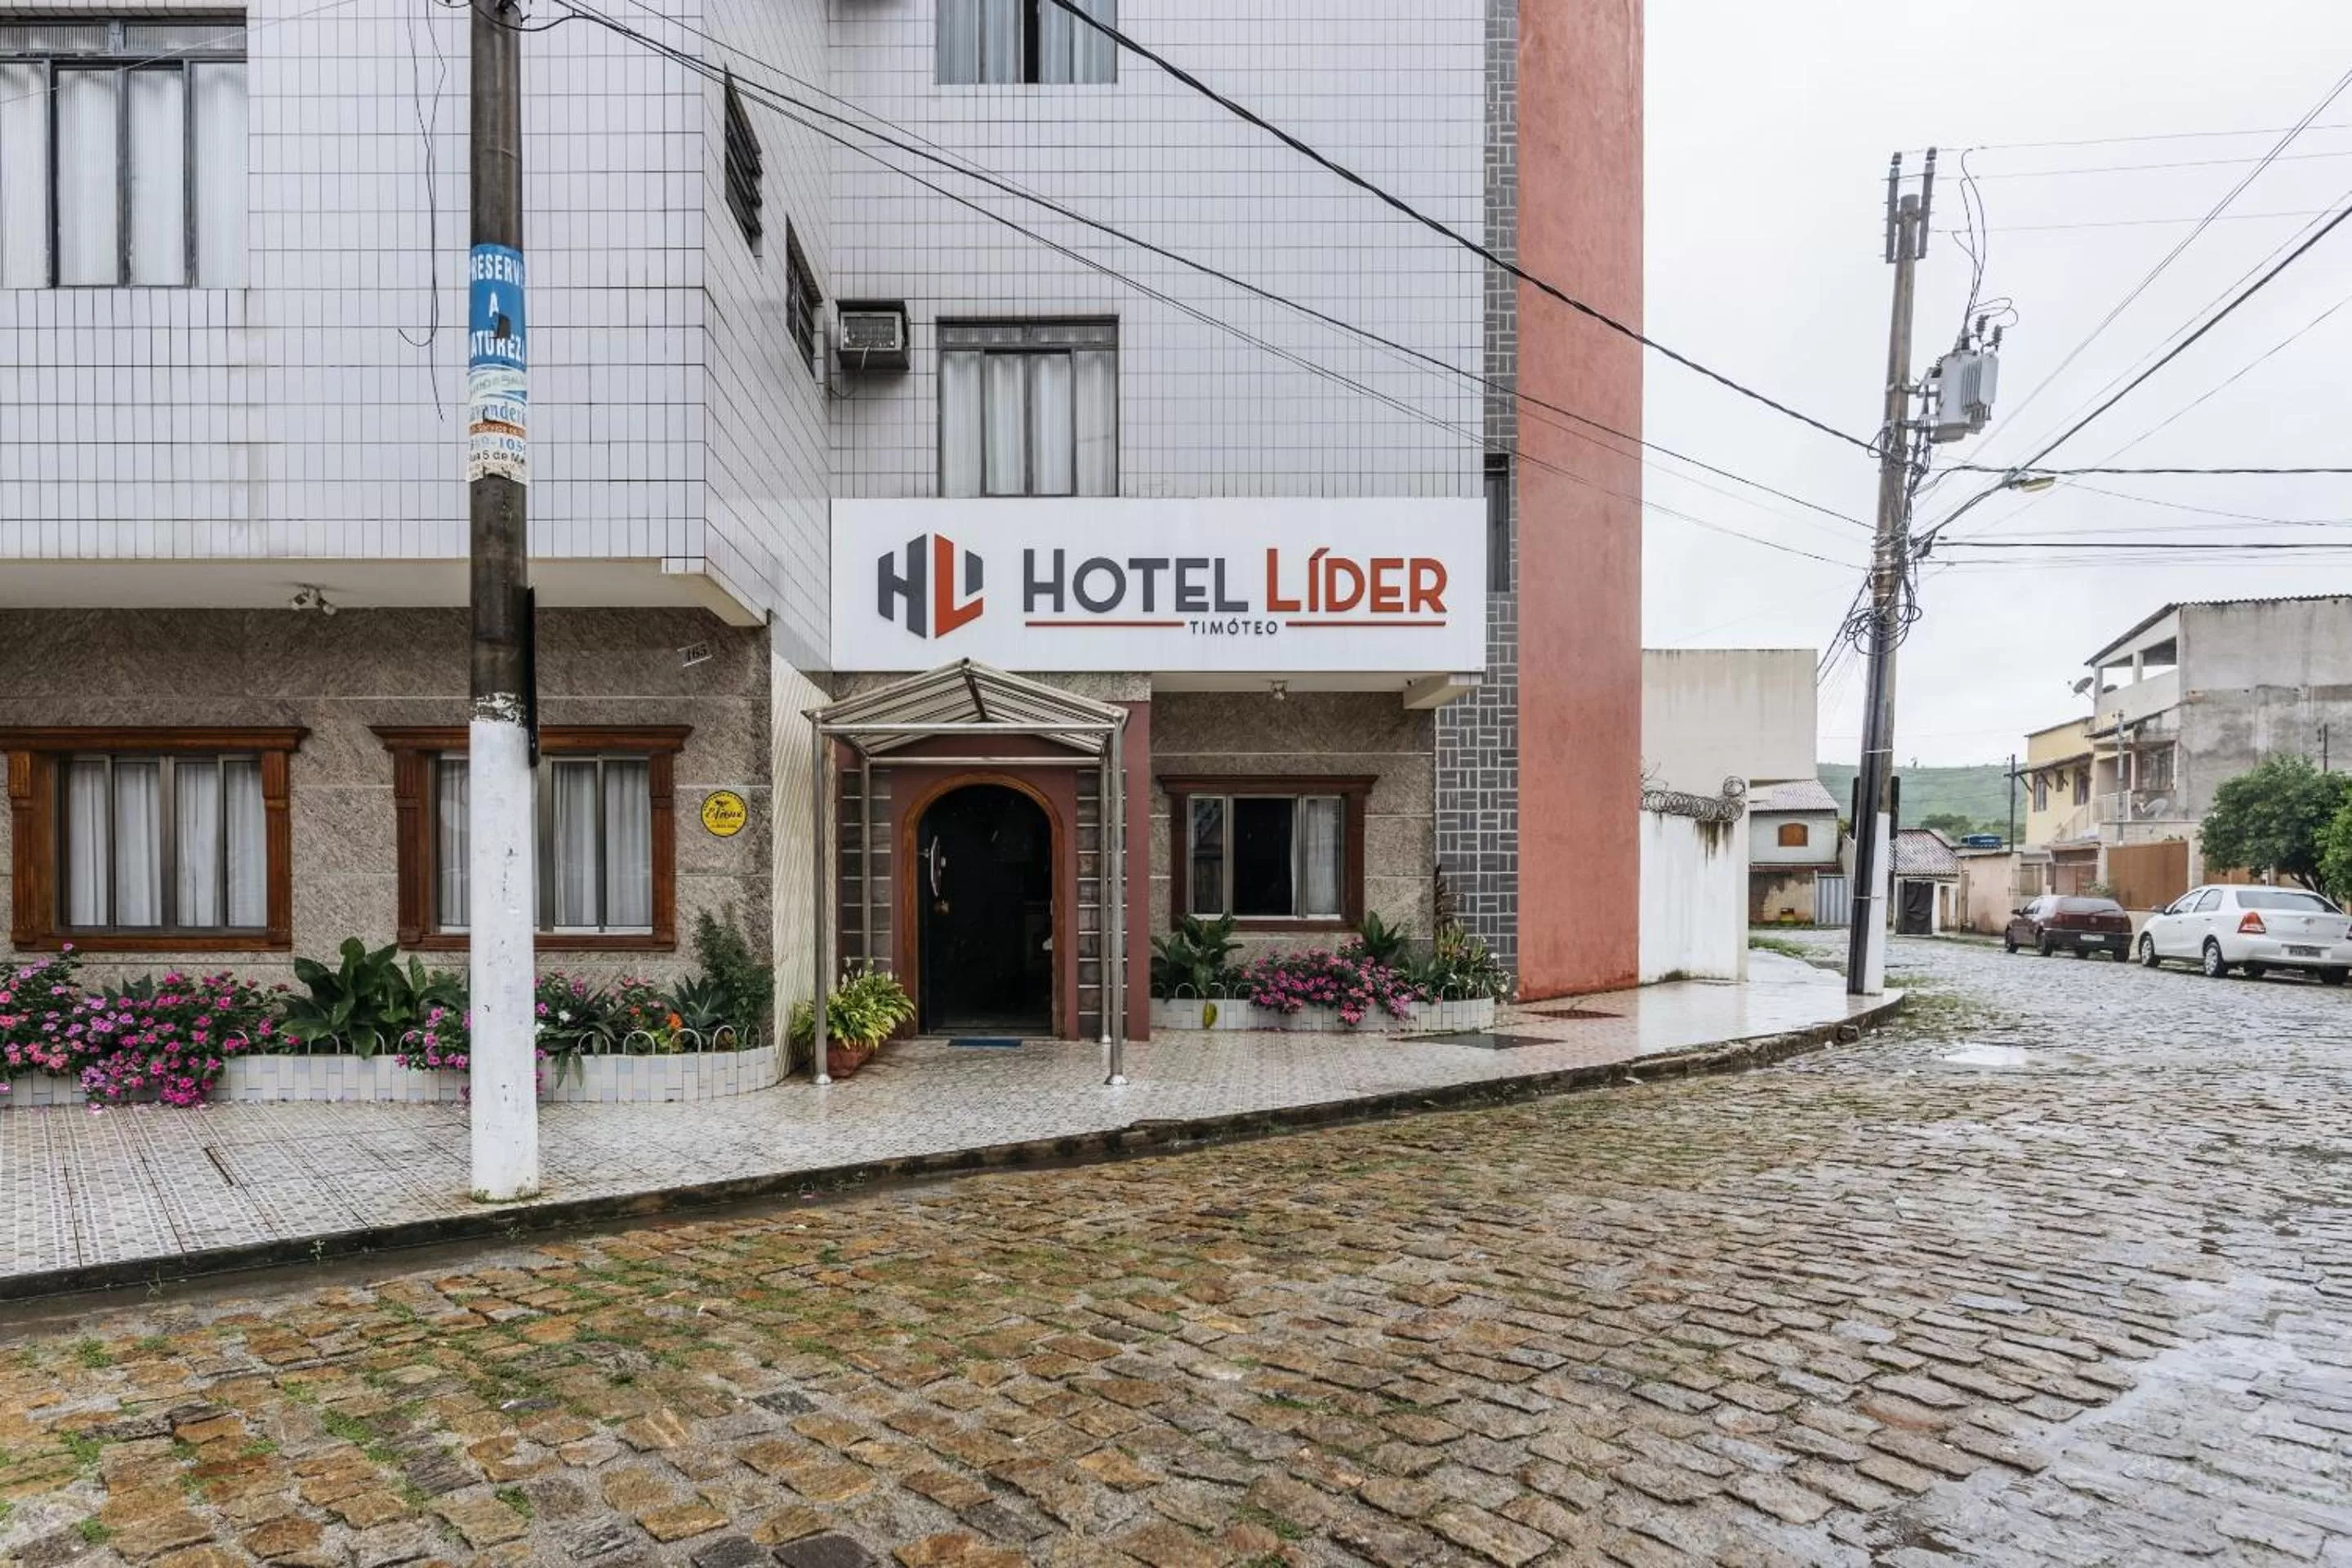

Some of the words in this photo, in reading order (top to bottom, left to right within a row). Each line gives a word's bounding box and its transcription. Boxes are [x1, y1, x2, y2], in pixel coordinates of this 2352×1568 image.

[470, 253, 524, 288] RESERV
[488, 292, 500, 318] A
[470, 330, 525, 364] ATUREZ
[1023, 548, 1250, 614] HOTEL
[1266, 547, 1448, 614] LÍDER
[1190, 617, 1278, 635] TIMÓTEO
